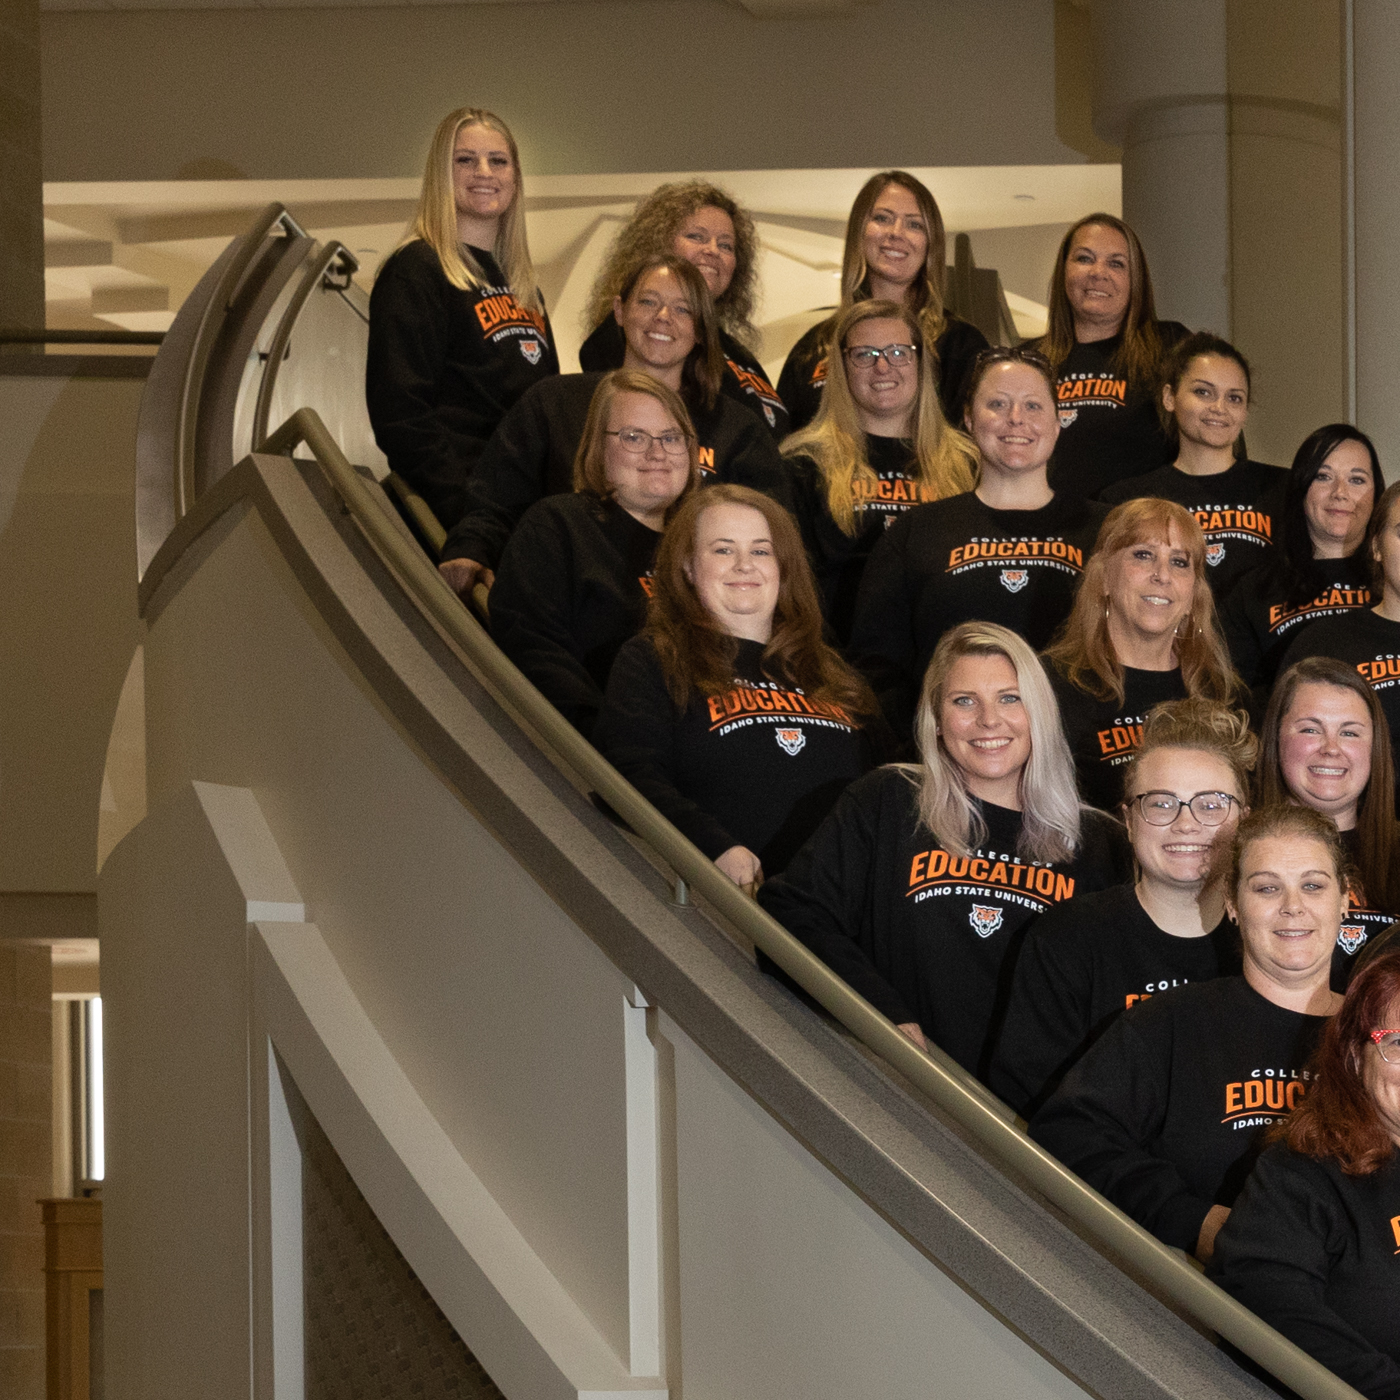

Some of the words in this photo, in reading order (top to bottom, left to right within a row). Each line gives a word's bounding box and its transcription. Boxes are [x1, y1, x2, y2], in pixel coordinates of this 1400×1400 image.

[870, 503, 898, 511] STATE
[1189, 505, 1229, 513] LLEGE
[1194, 510, 1272, 538] CATION
[1215, 532, 1266, 548] UNIVERSITY
[949, 541, 1083, 568] EDUCATION
[953, 562, 984, 575] IDAHO
[1020, 560, 1077, 576] UNIVERSITY
[1277, 615, 1303, 635] IDAHO
[1306, 610, 1333, 620] STATE
[1372, 681, 1395, 691] AHO
[719, 718, 754, 737] IDAHO
[755, 716, 787, 724] STATE
[788, 716, 852, 734] UNIVERSITY
[909, 850, 1075, 902] EDUCATION
[915, 886, 951, 903] IDAHO
[955, 886, 991, 897] STATE
[994, 890, 1047, 914] UNIVERS
[1233, 1118, 1272, 1130] IDAHO
